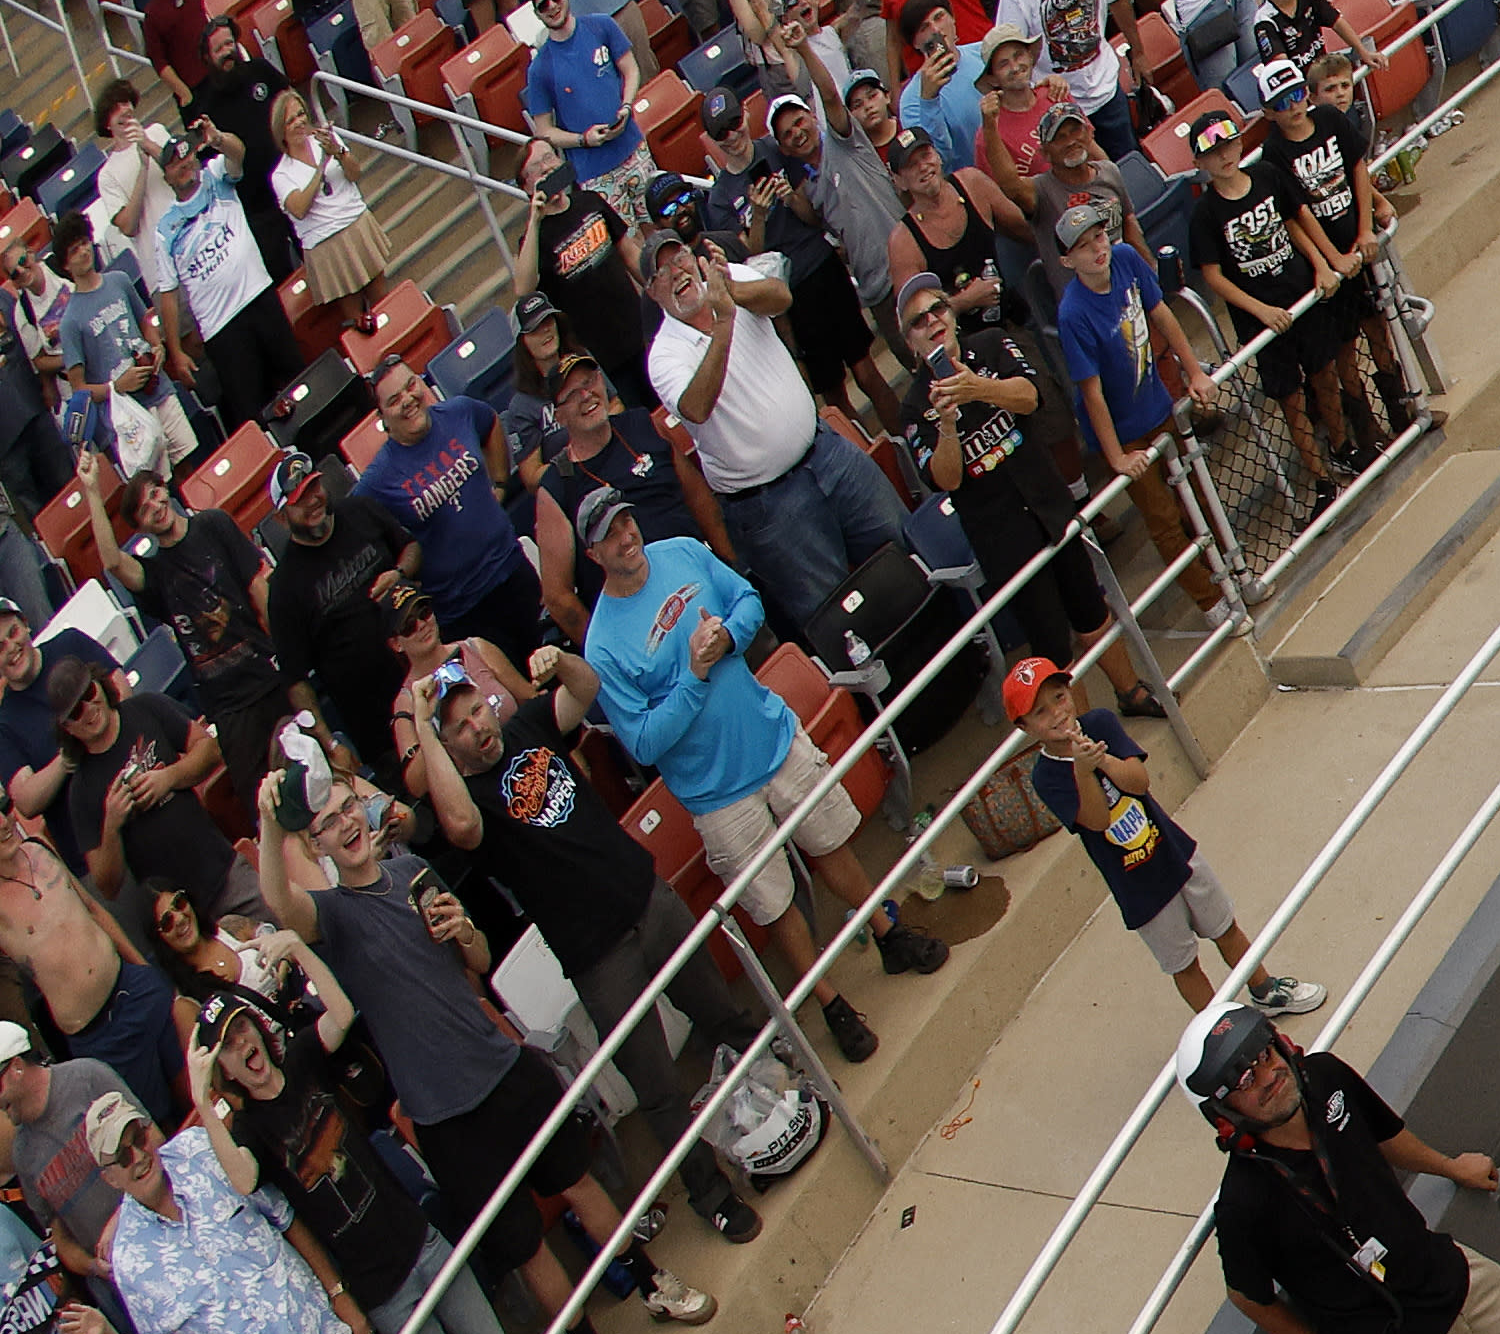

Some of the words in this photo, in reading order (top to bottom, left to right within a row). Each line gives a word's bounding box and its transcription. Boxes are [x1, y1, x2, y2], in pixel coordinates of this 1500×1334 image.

[1294, 135, 1343, 176] KYLE
[1226, 196, 1281, 242] FAST
[188, 223, 234, 278] BUSCH
[201, 249, 230, 281] LIGHT
[402, 439, 467, 497] TEXAS
[413, 450, 480, 521] RANGERS
[538, 775, 576, 827] HAPPEN
[1110, 804, 1146, 844] NAPA
[205, 996, 224, 1023] CAT
[768, 1130, 788, 1154] PIT
